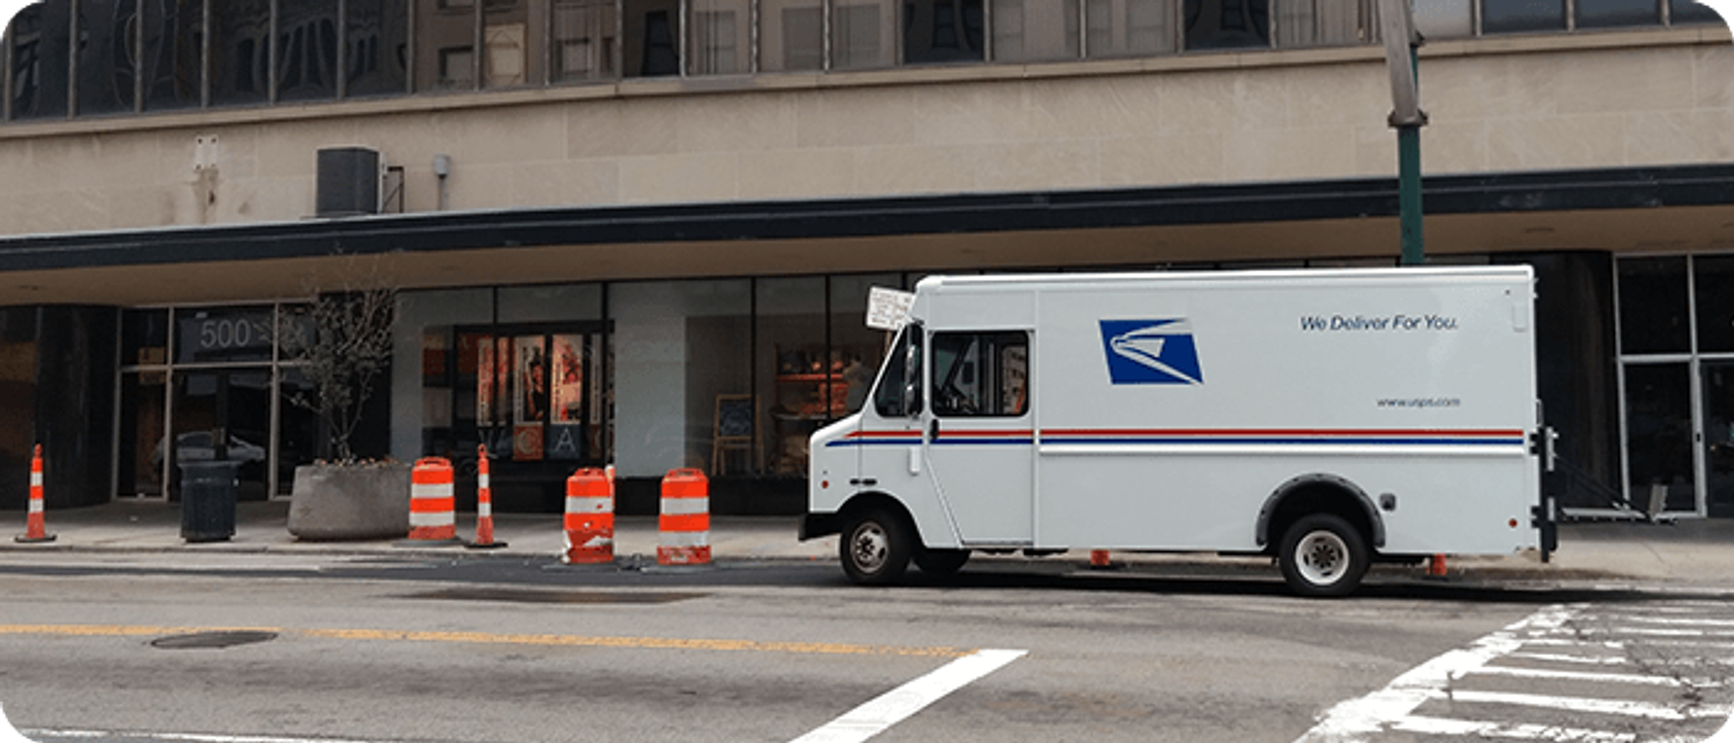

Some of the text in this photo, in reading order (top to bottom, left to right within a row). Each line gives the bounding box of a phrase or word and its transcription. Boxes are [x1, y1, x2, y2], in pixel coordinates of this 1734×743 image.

[200, 318, 251, 349] 500
[1300, 315, 1459, 331] We Deliver For You.
